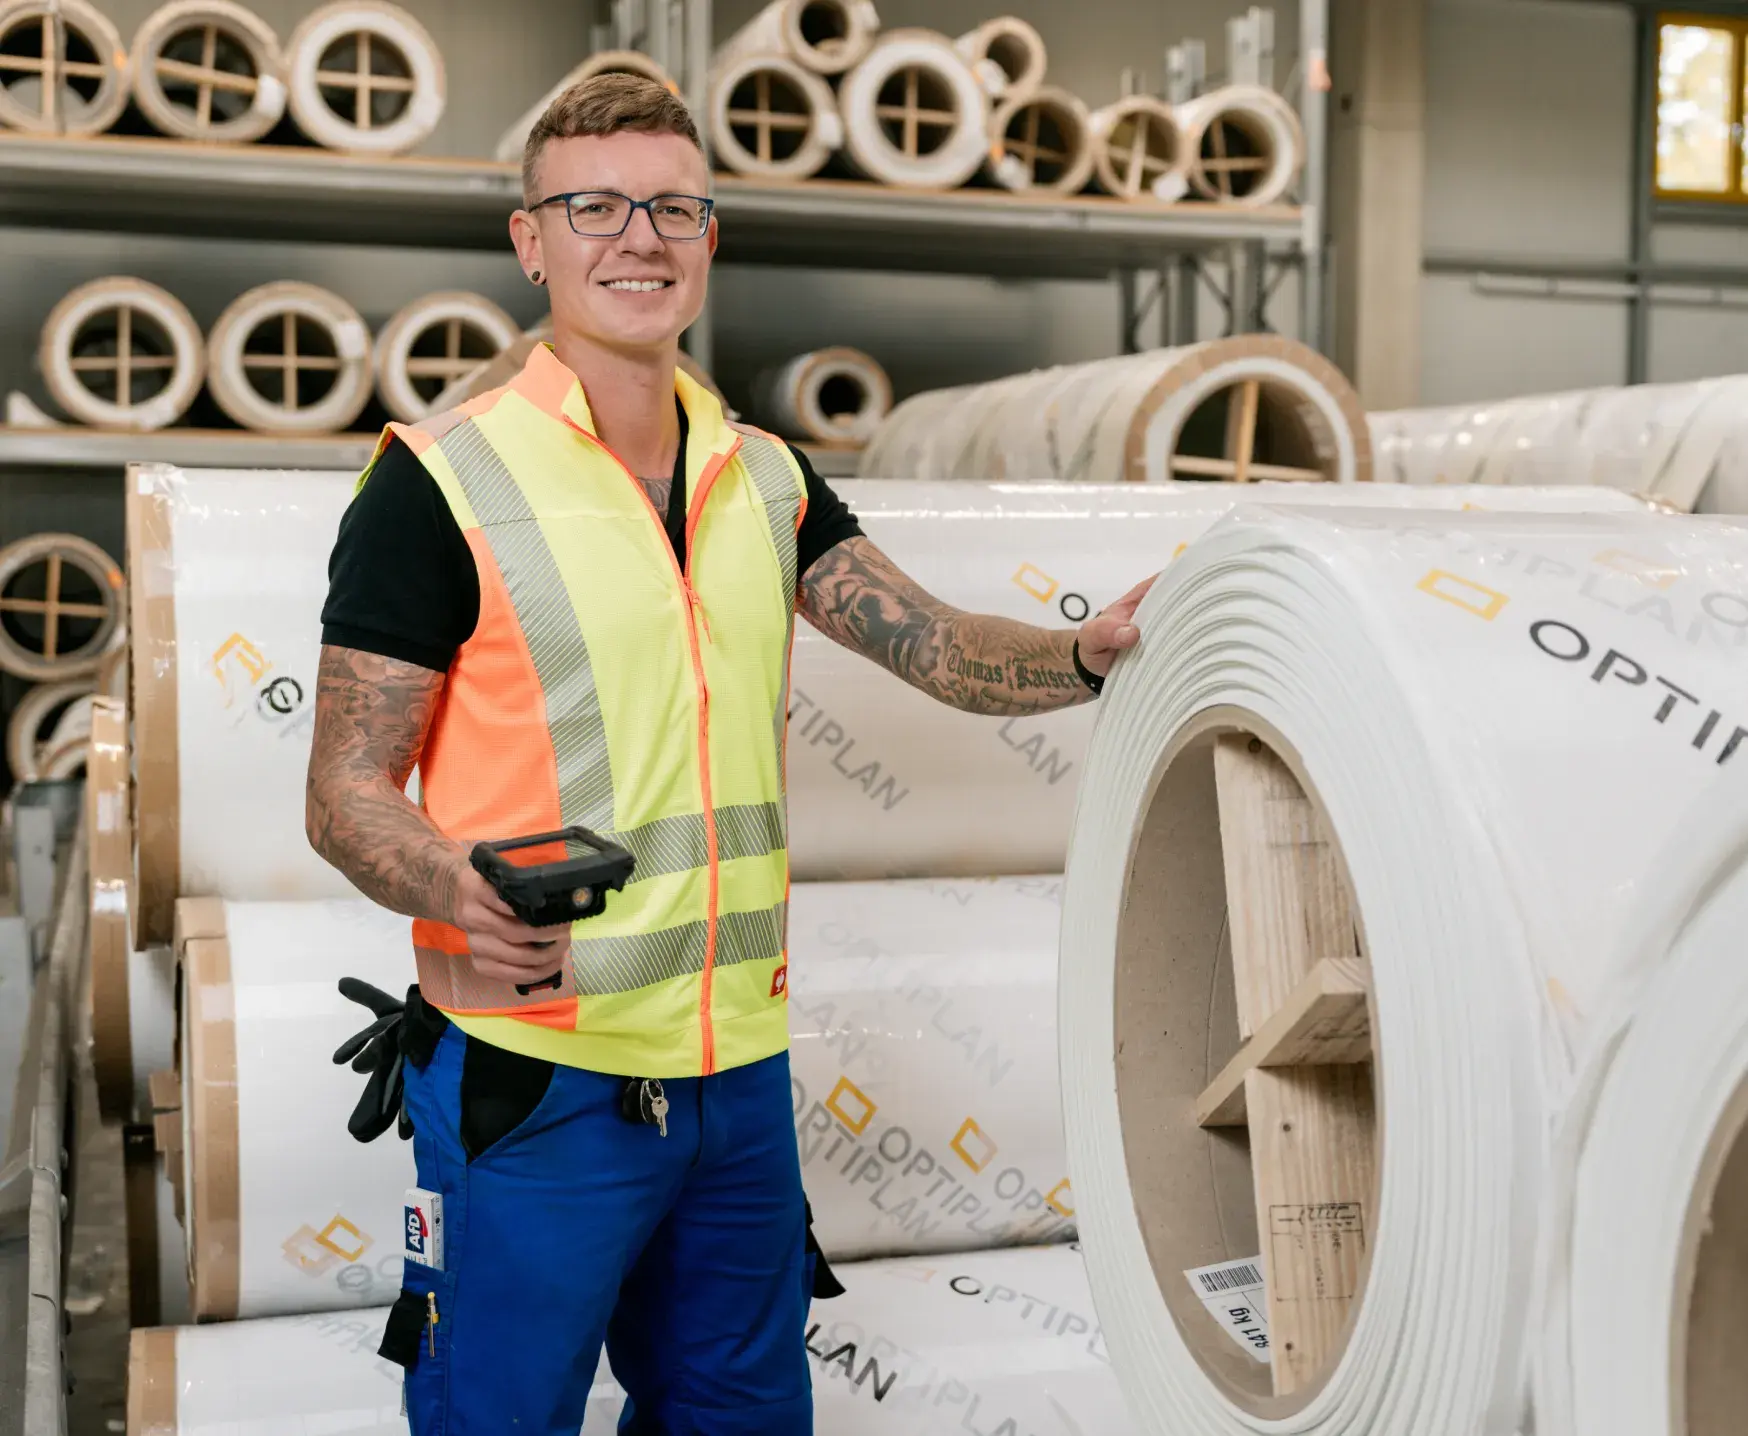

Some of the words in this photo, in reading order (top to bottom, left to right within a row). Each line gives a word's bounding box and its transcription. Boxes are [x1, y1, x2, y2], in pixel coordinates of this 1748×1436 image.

[947, 643, 1004, 684] Thomas
[1007, 655, 1080, 692] Kaiser
[408, 1212, 421, 1250] AfD
